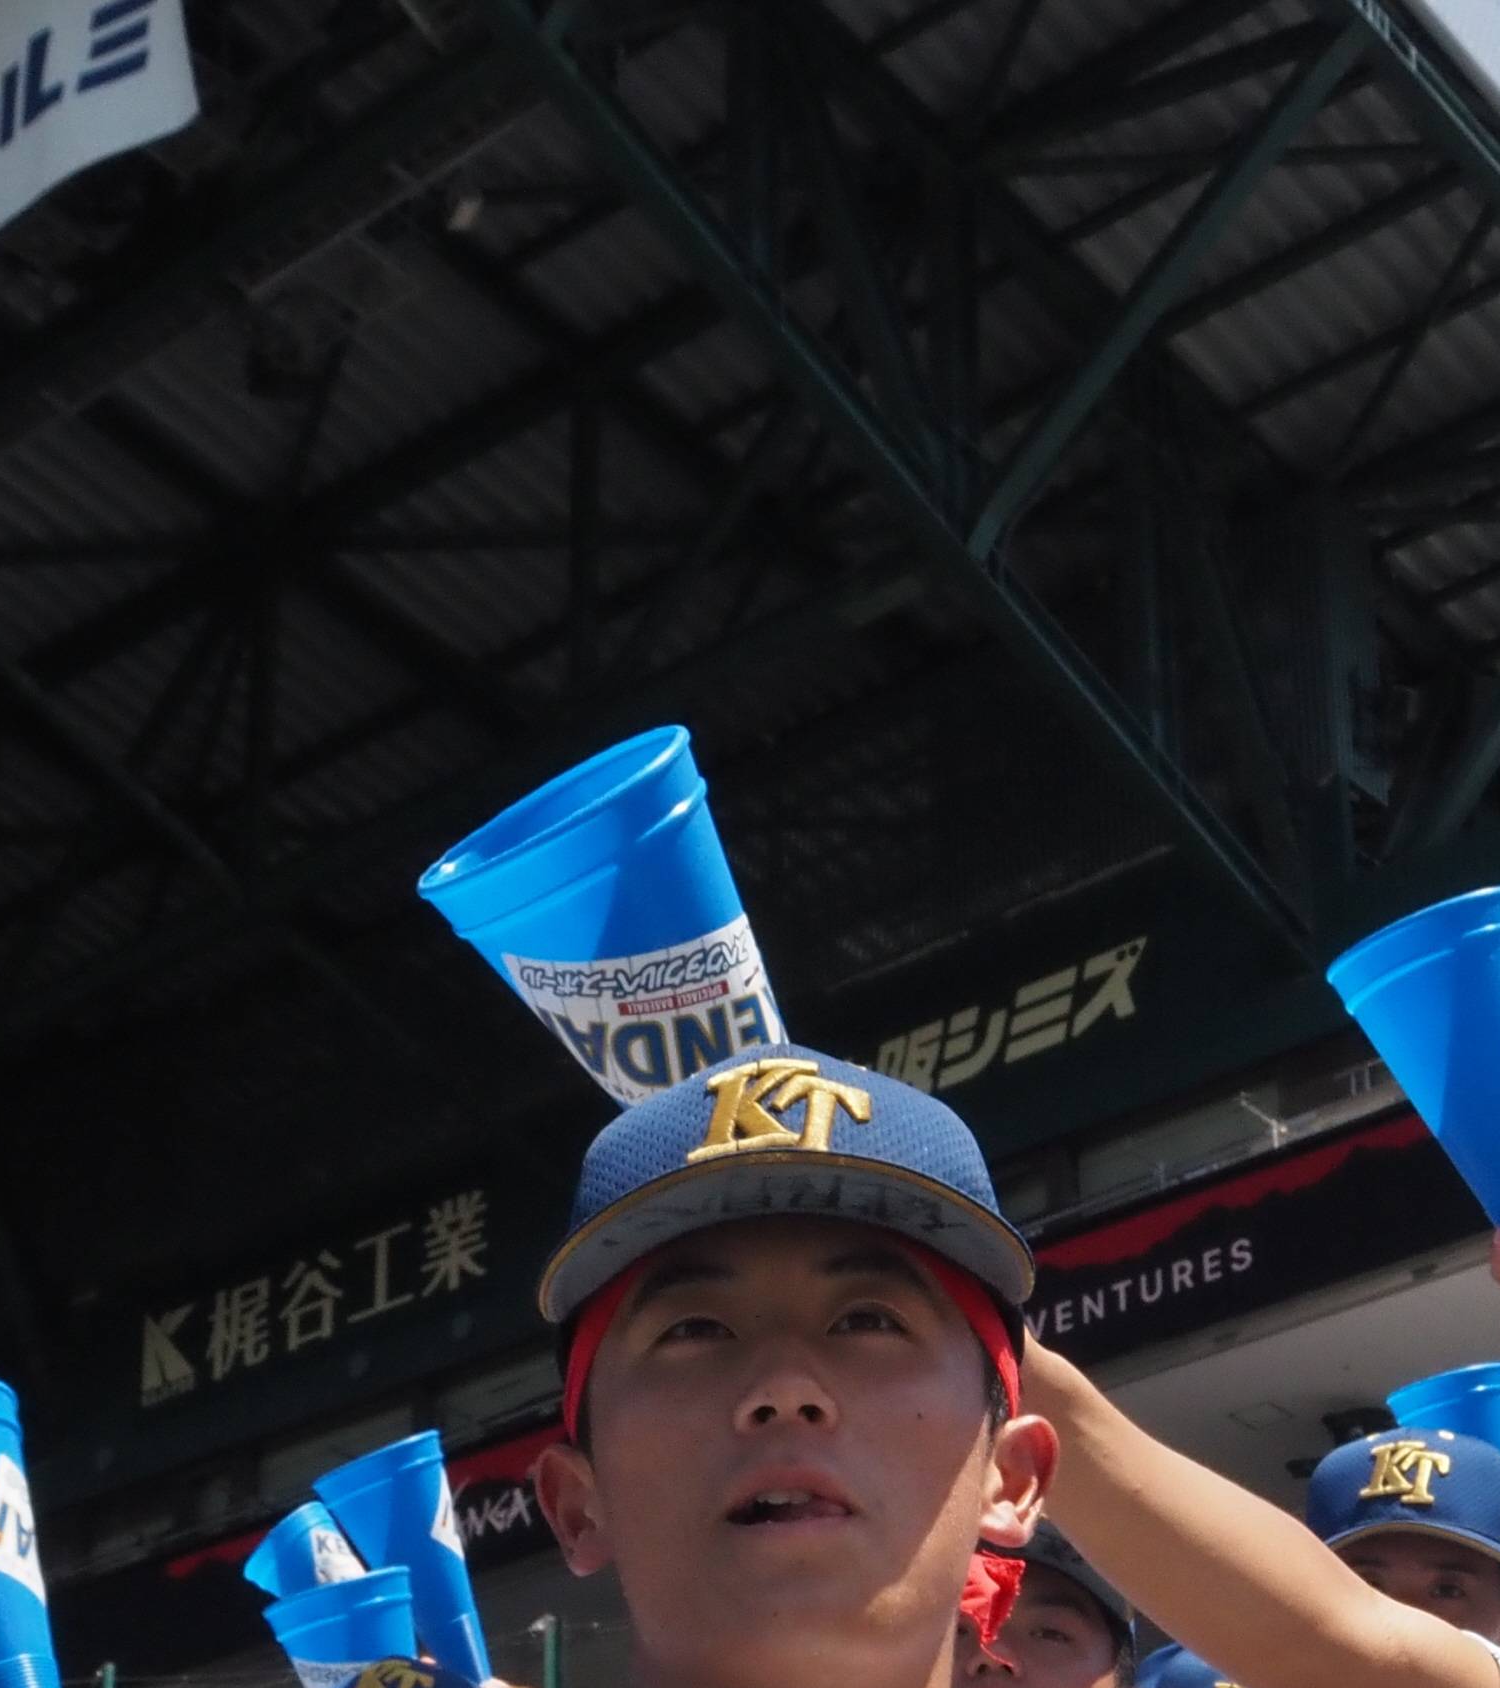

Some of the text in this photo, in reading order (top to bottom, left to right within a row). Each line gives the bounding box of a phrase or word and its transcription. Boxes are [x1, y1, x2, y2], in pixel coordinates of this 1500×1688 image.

[686, 1057, 873, 1165] KT
[205, 1190, 490, 1383] 梶谷工業
[1359, 1440, 1451, 1506] KT
